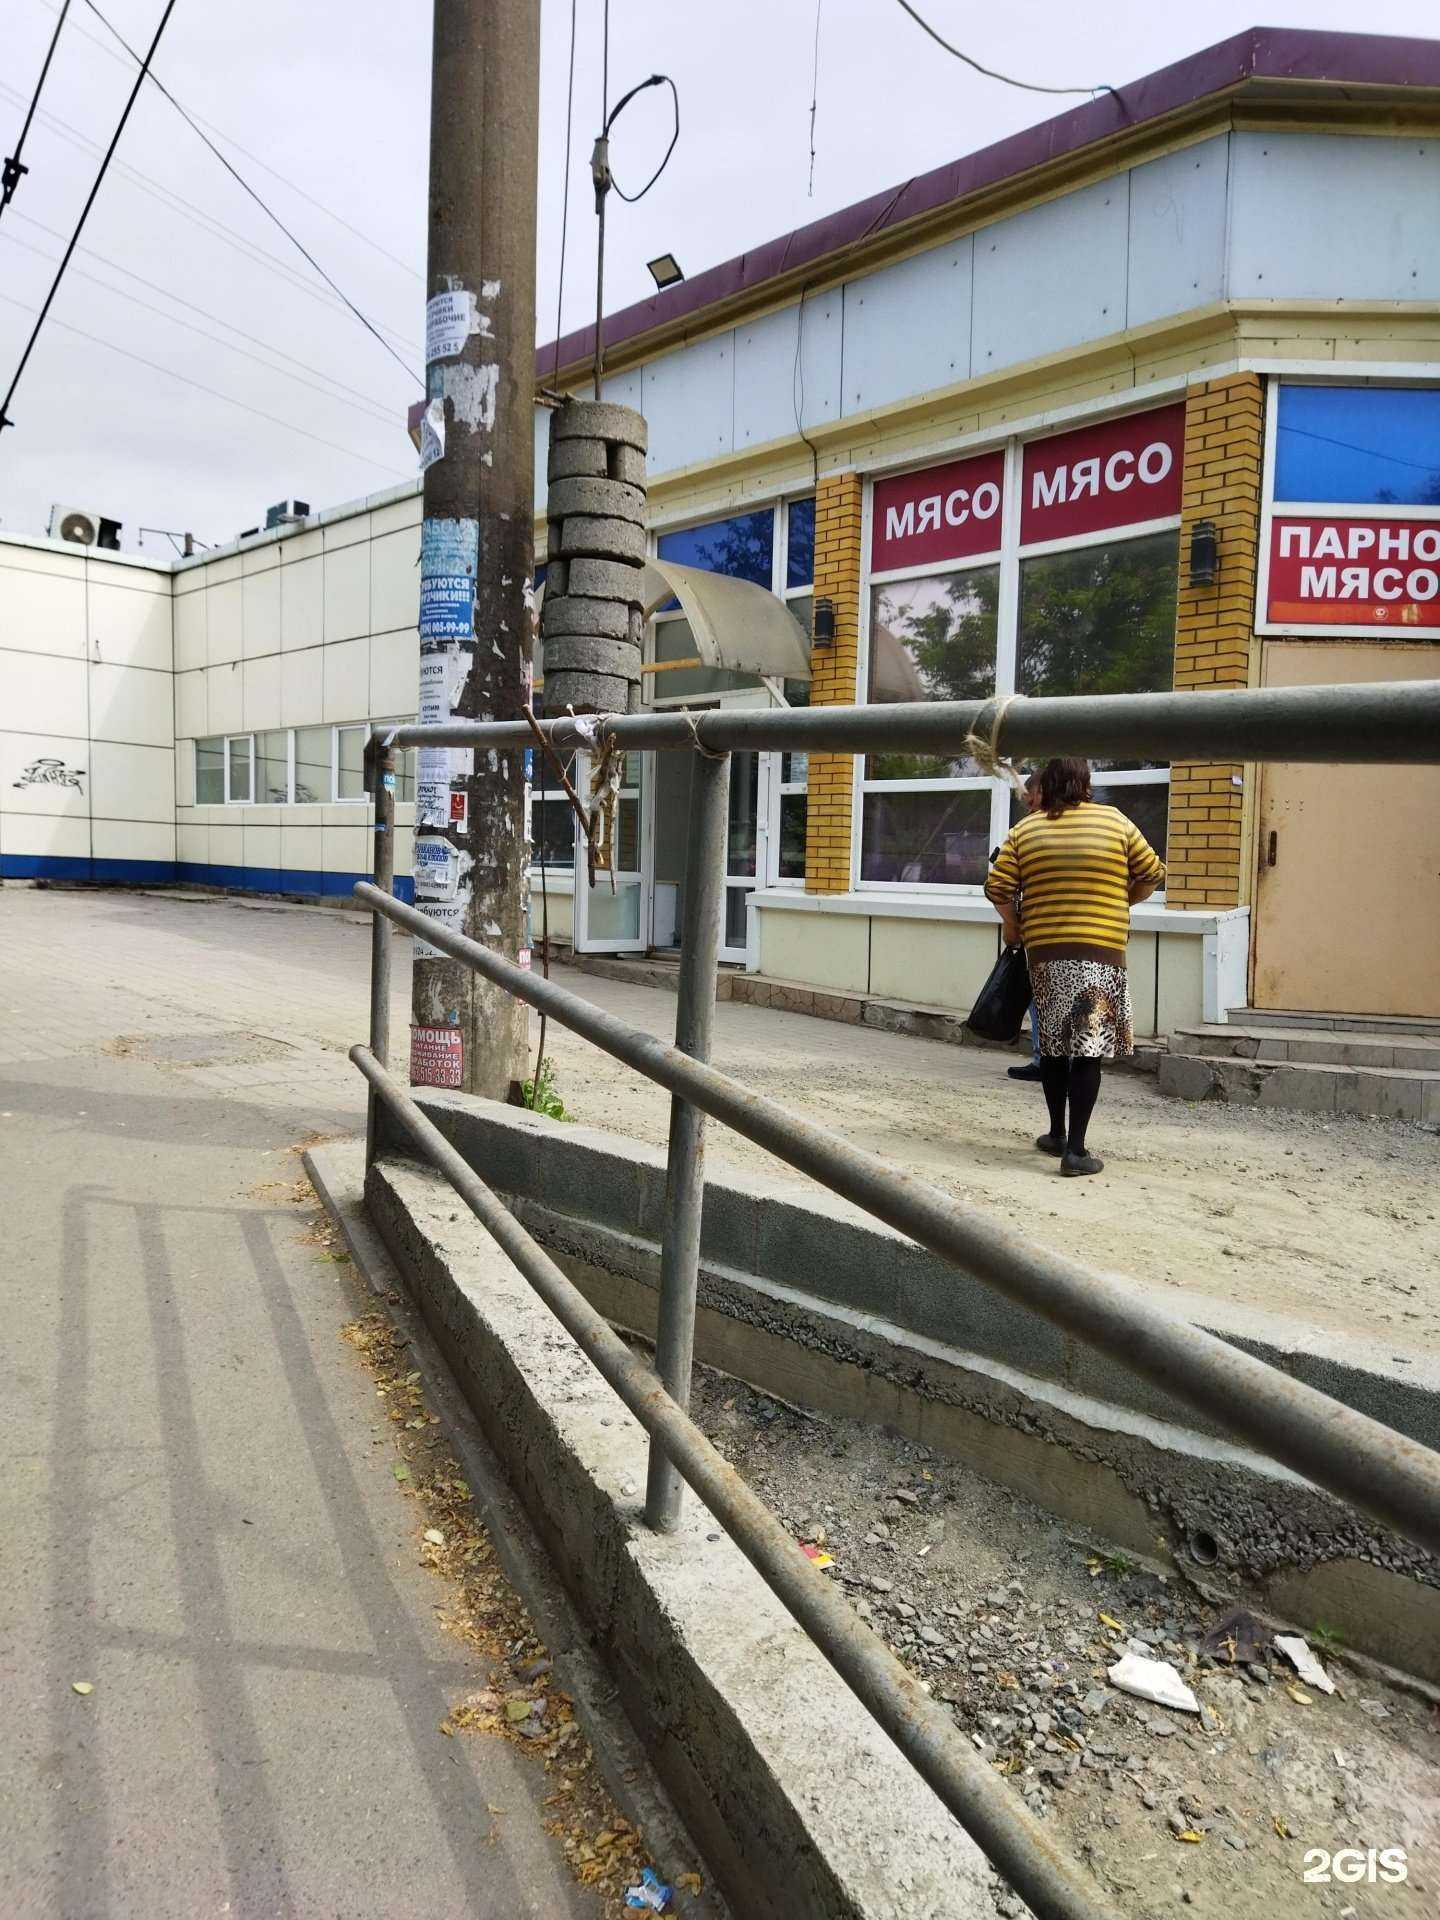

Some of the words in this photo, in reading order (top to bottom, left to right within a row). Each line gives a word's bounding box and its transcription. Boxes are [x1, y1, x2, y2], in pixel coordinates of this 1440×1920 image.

[1032, 442, 1173, 509] МЯСО
[885, 482, 1000, 541] МЯСО
[1300, 566, 1439, 601] МЯСО
